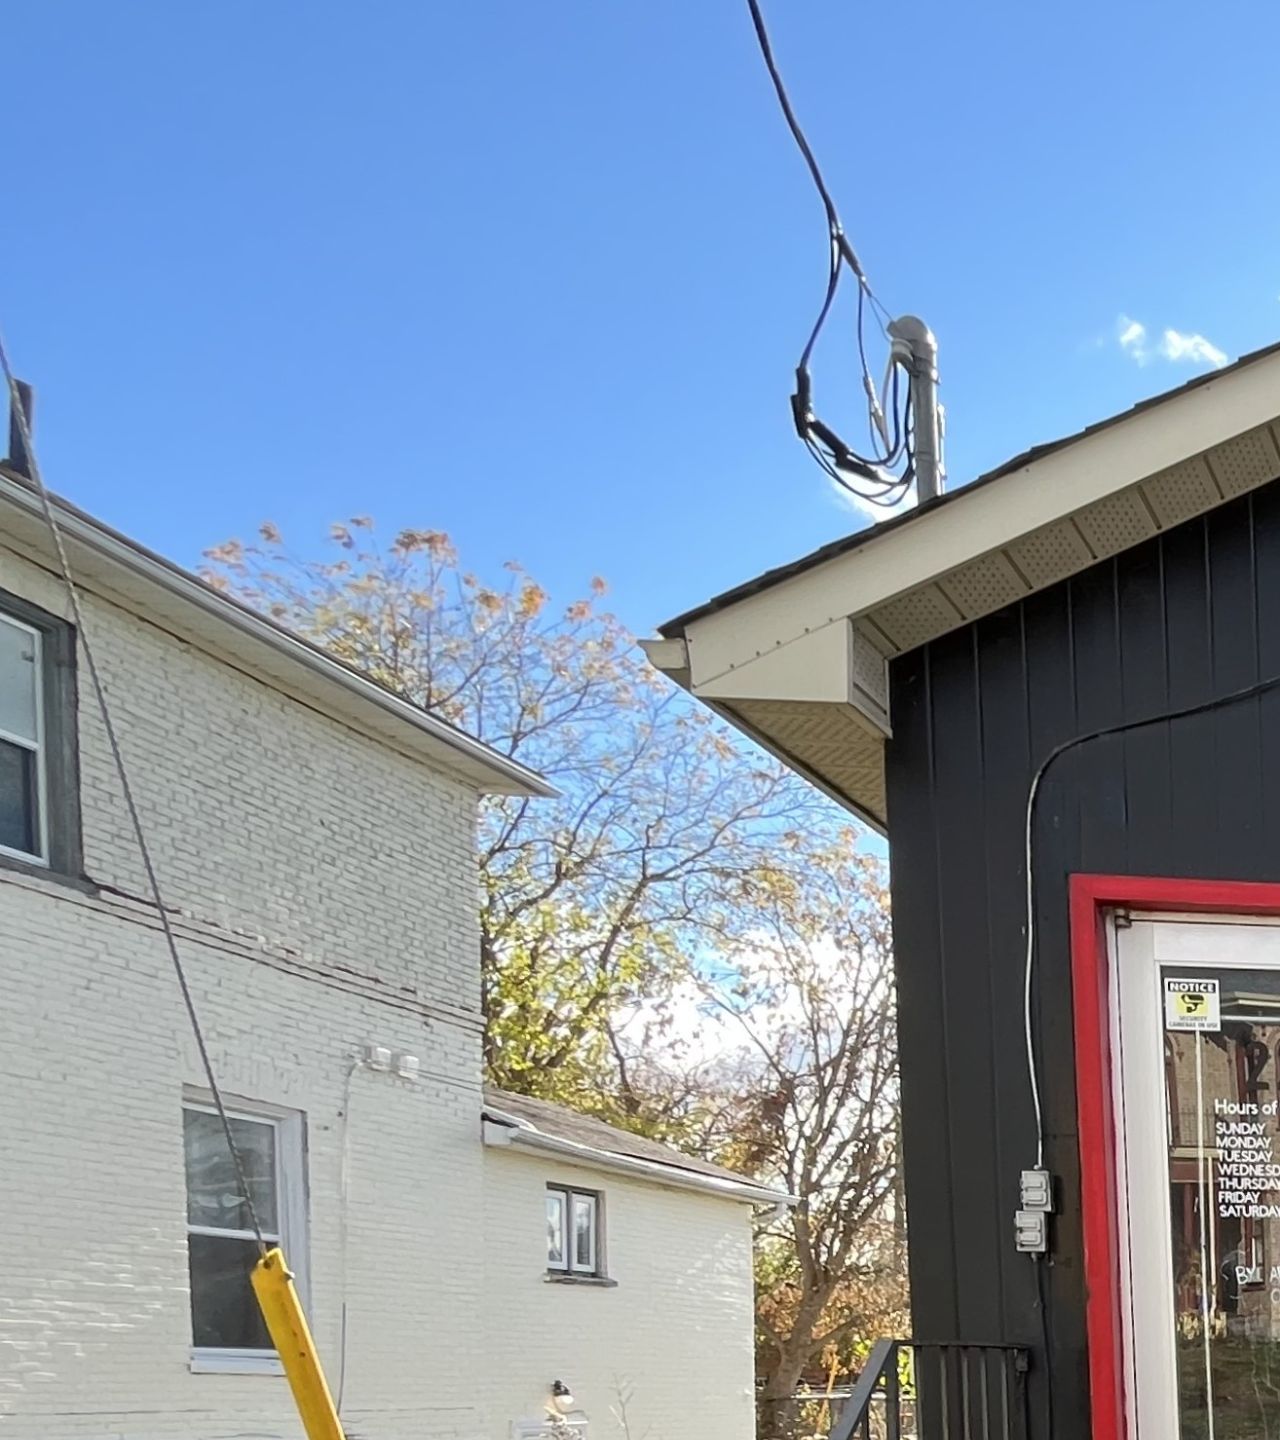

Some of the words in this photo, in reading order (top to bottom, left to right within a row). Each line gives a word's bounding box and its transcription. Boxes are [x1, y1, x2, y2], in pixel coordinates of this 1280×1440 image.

[1168, 981, 1215, 994] NOTICE
[1214, 1099, 1259, 1115] Hours
[1261, 1100, 1279, 1115] of
[1215, 1122, 1267, 1136] SUNDAY
[1215, 1136, 1272, 1149] MONDAY
[1217, 1150, 1273, 1163] TUESDAY
[1218, 1191, 1261, 1204] FRIDAY
